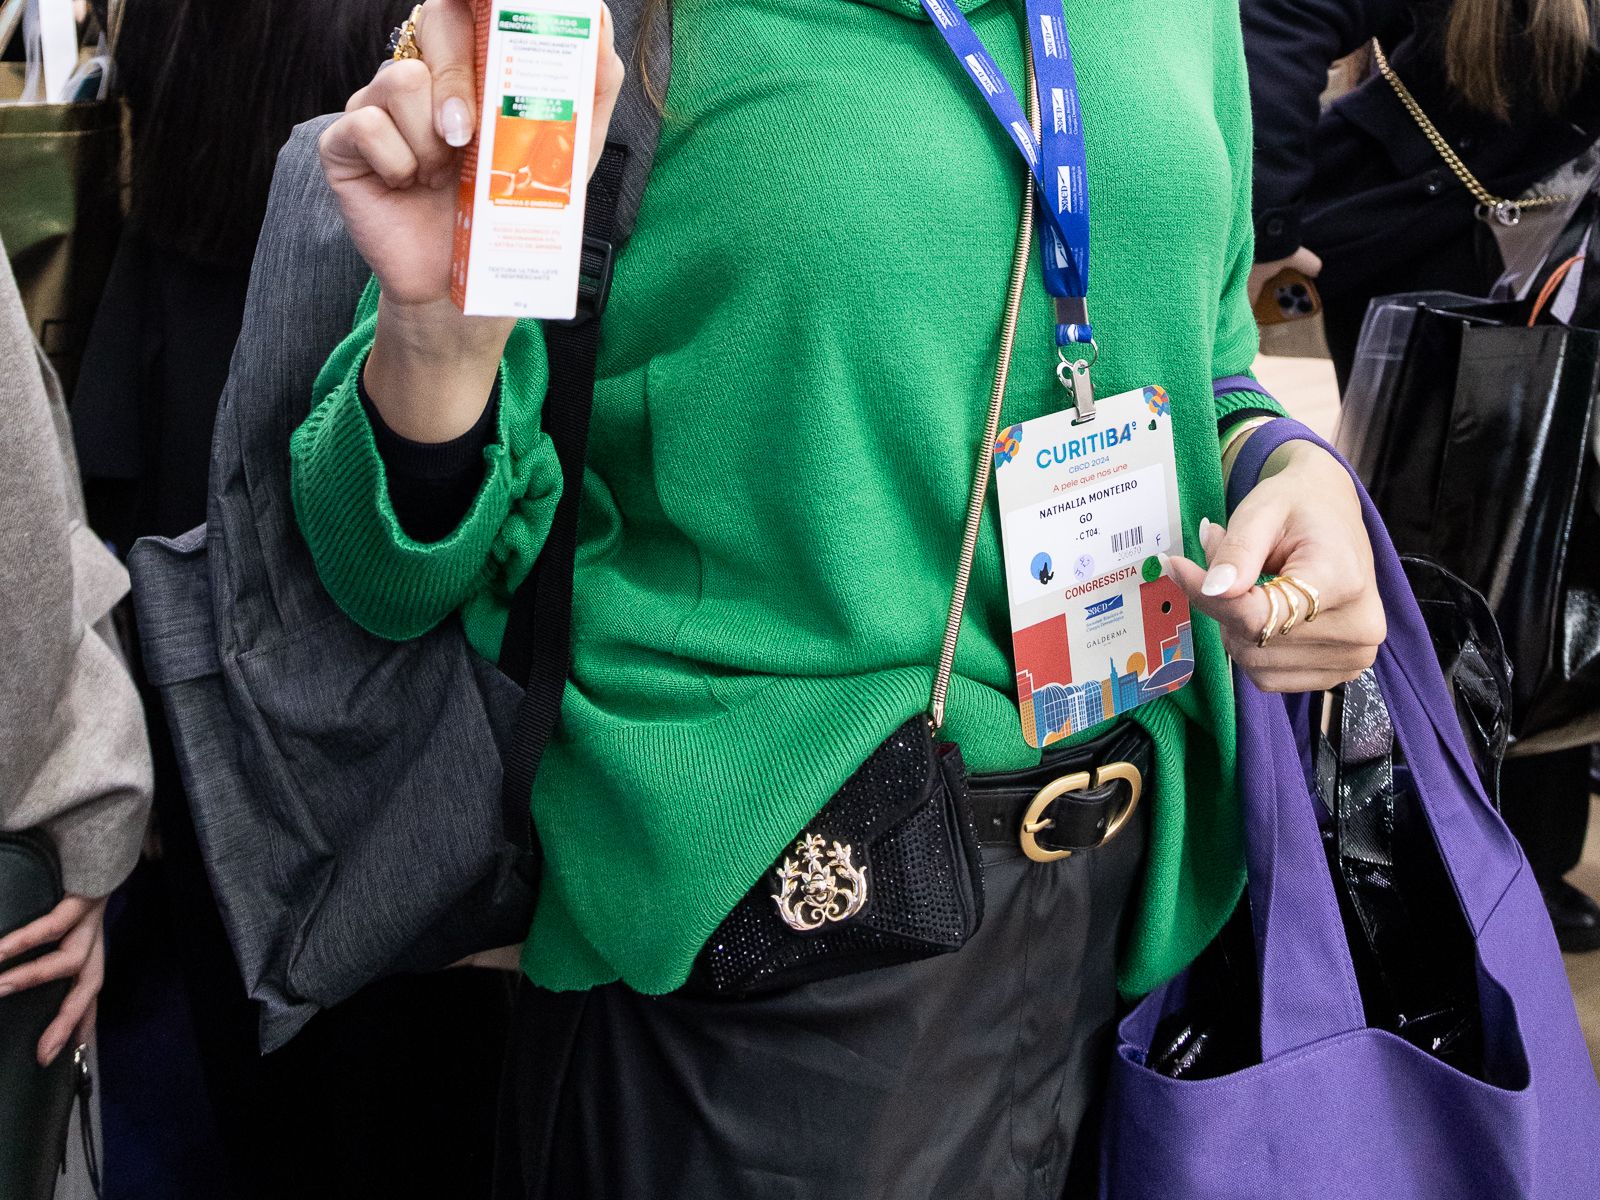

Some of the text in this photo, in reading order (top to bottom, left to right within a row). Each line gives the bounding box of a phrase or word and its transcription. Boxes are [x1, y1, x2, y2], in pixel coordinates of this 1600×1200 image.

[1052, 462, 1128, 494] A pele que nos une
[1068, 455, 1110, 475] CBCD 2024
[1039, 479, 1138, 519] NATHALIA MONTEIRO
[1079, 512, 1093, 524] GO
[1064, 565, 1138, 600] CONGRESSISTA
[1086, 628, 1127, 649] GALDERMA
